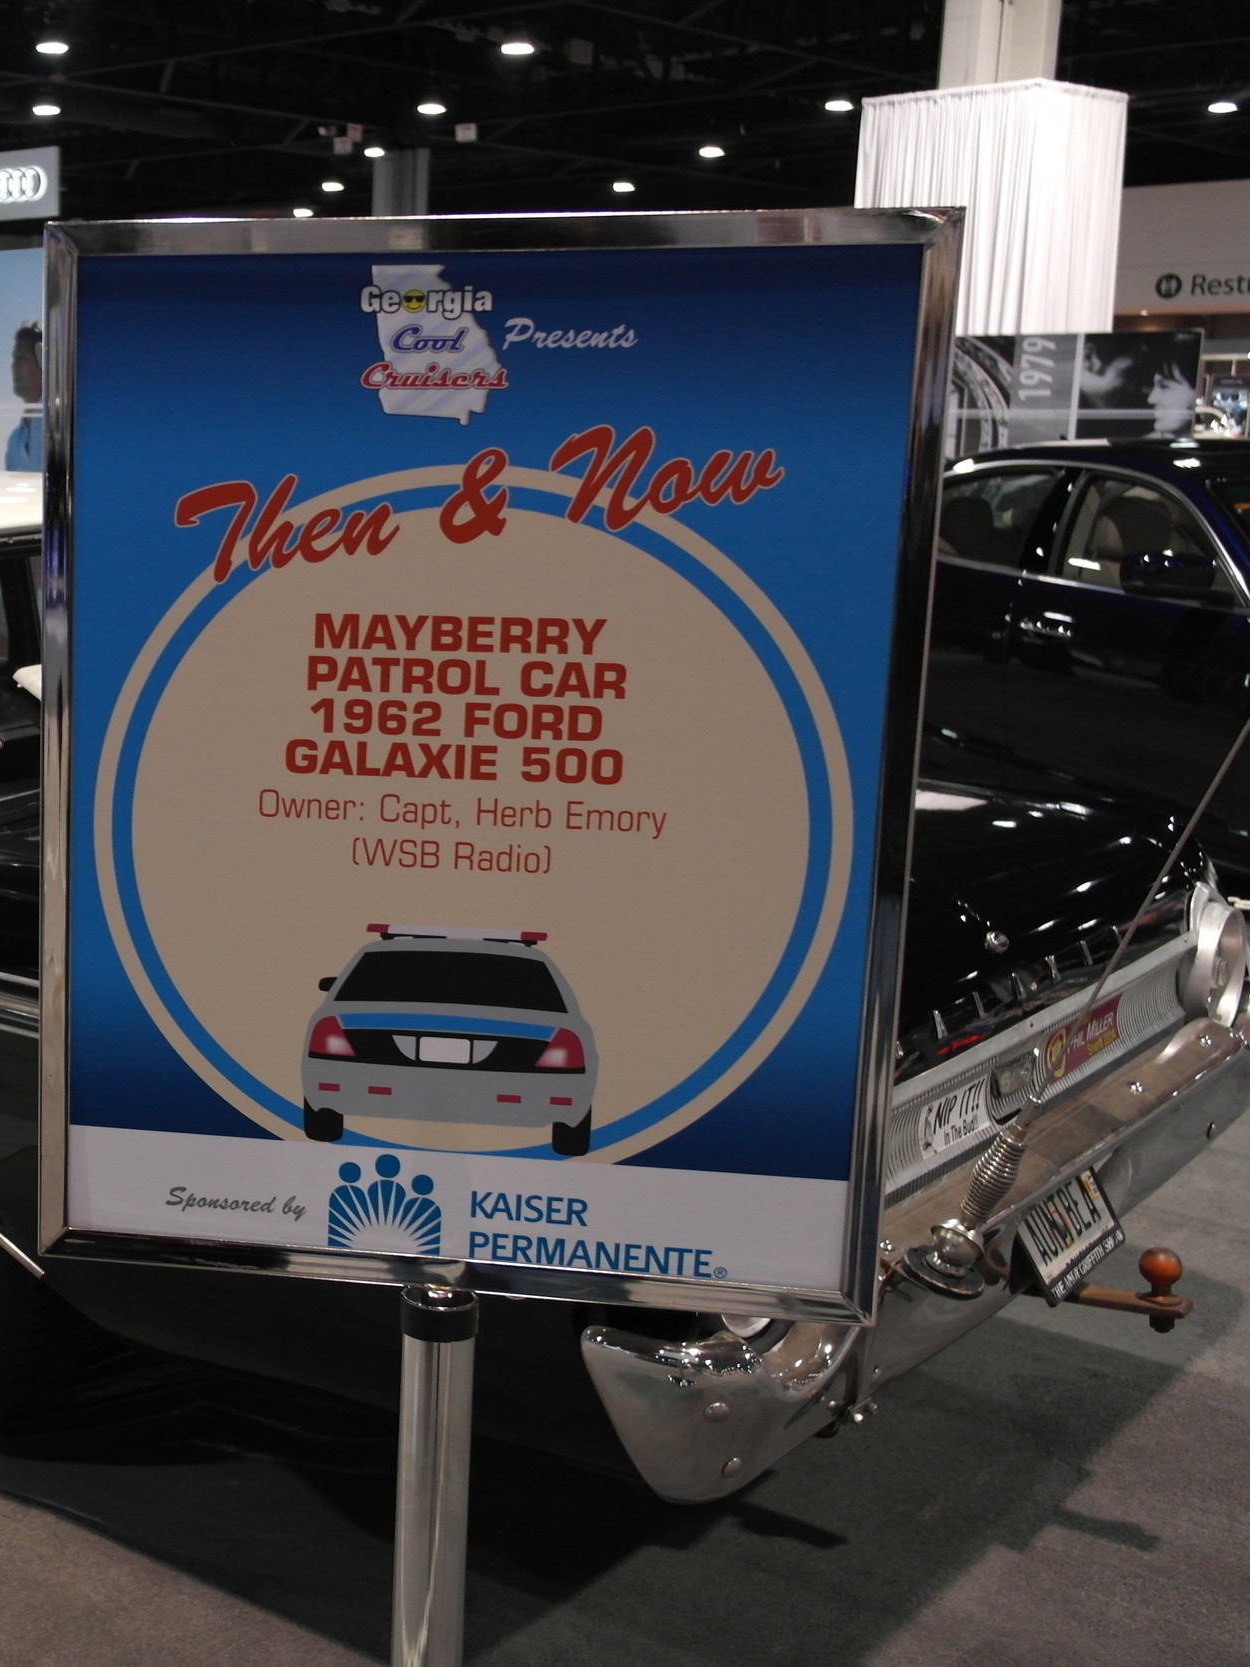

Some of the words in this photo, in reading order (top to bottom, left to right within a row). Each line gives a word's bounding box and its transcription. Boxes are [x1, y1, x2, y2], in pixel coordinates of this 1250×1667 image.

[390, 324, 470, 352] Cool
[502, 317, 639, 351] Presents
[360, 362, 510, 389] Cruisers
[1018, 336, 1056, 401] 1979
[174, 474, 401, 584] Then
[439, 447, 509, 544] &
[550, 424, 785, 532] Now
[314, 613, 608, 655] MAYBERRY
[307, 655, 500, 696] PATROL
[519, 661, 627, 700] CAR
[310, 698, 442, 737] 1962
[463, 702, 603, 742] FORD
[285, 739, 498, 781] GALAXIE
[521, 746, 623, 785] 500
[258, 789, 365, 822] Owner:
[379, 793, 461, 830] Capt,
[476, 797, 552, 829] Herb
[565, 801, 668, 840] Emory
[352, 837, 440, 869] (WSB
[453, 841, 552, 874] Radio)
[933, 1094, 958, 1135] NIP
[958, 1078, 986, 1119] IT!!
[951, 1124, 963, 1142] The
[165, 1186, 277, 1213] Sponsored
[282, 1195, 307, 1222] by
[470, 1190, 588, 1227] KAISER
[1052, 1280, 1066, 1299] THE
